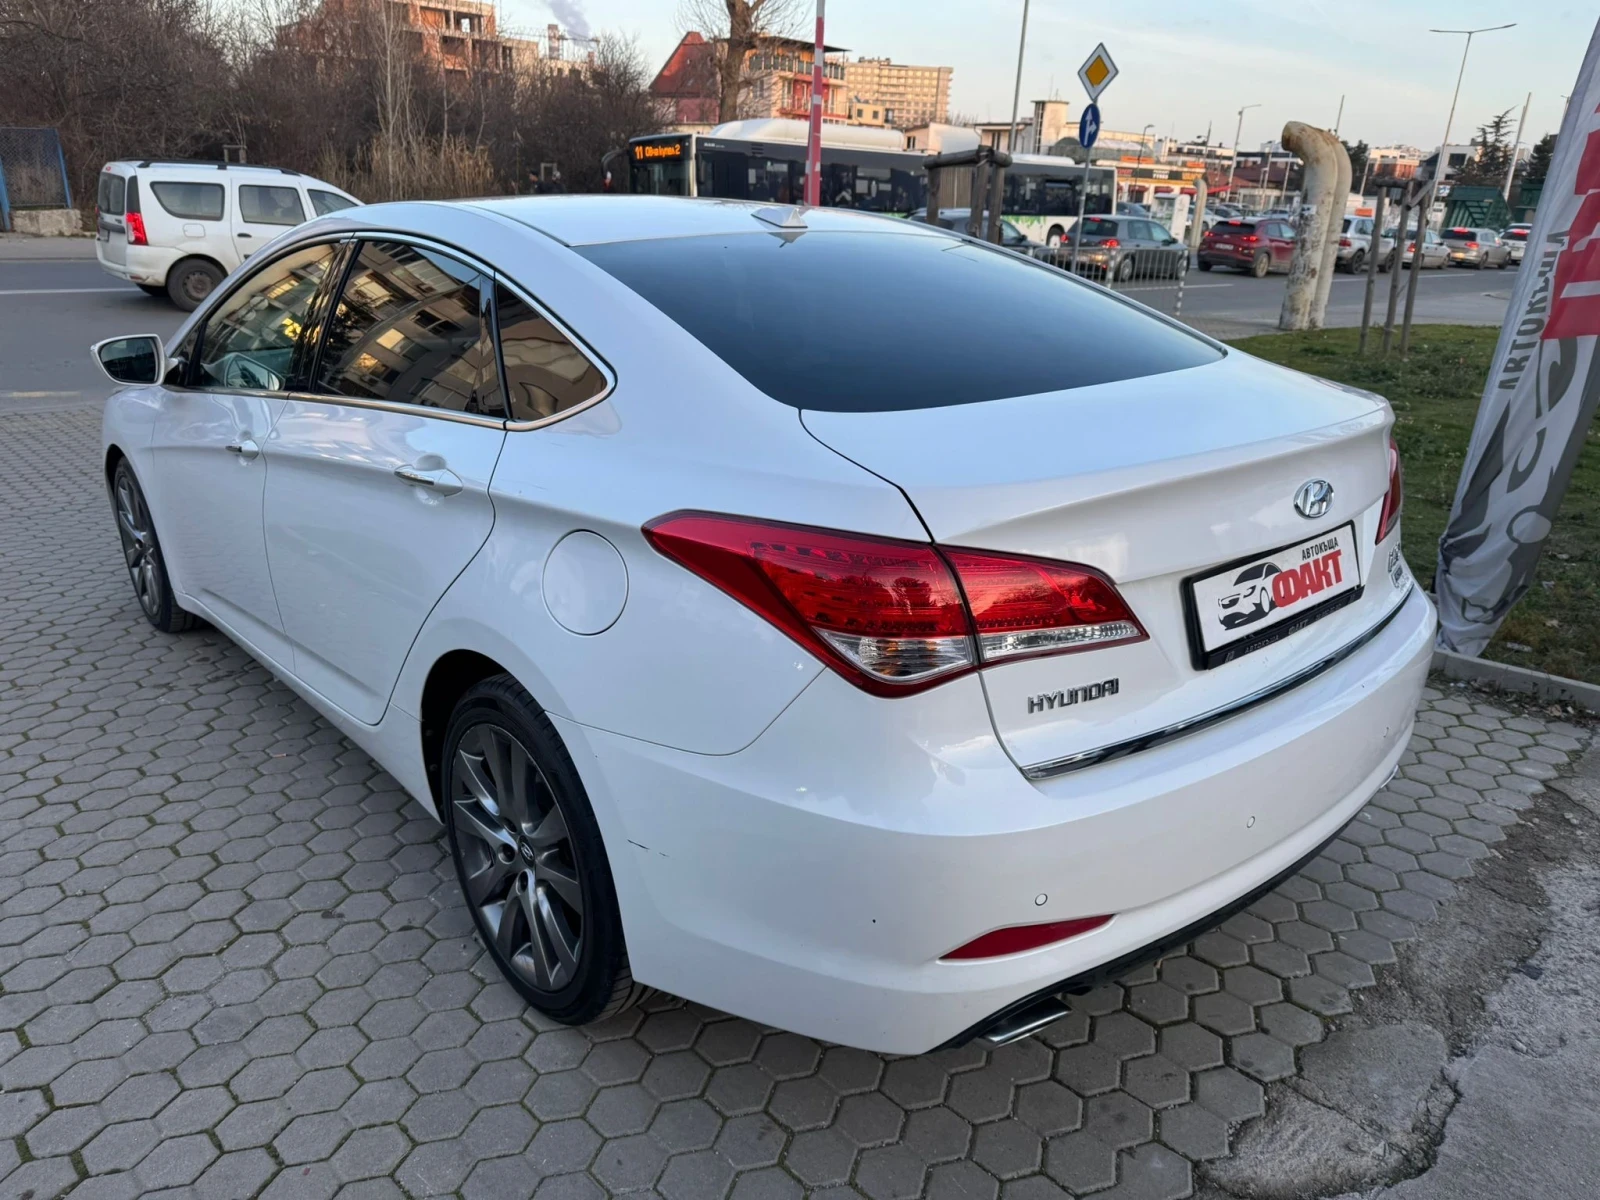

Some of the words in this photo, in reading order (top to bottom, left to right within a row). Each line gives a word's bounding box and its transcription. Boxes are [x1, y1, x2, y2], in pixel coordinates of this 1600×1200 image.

[635, 145, 643, 159] 11
[675, 144, 681, 155] 2
[1302, 537, 1339, 560] АВТОКЪЩА
[1272, 548, 1343, 608] ФАКТ
[1028, 678, 1119, 714] HYUNDAI
